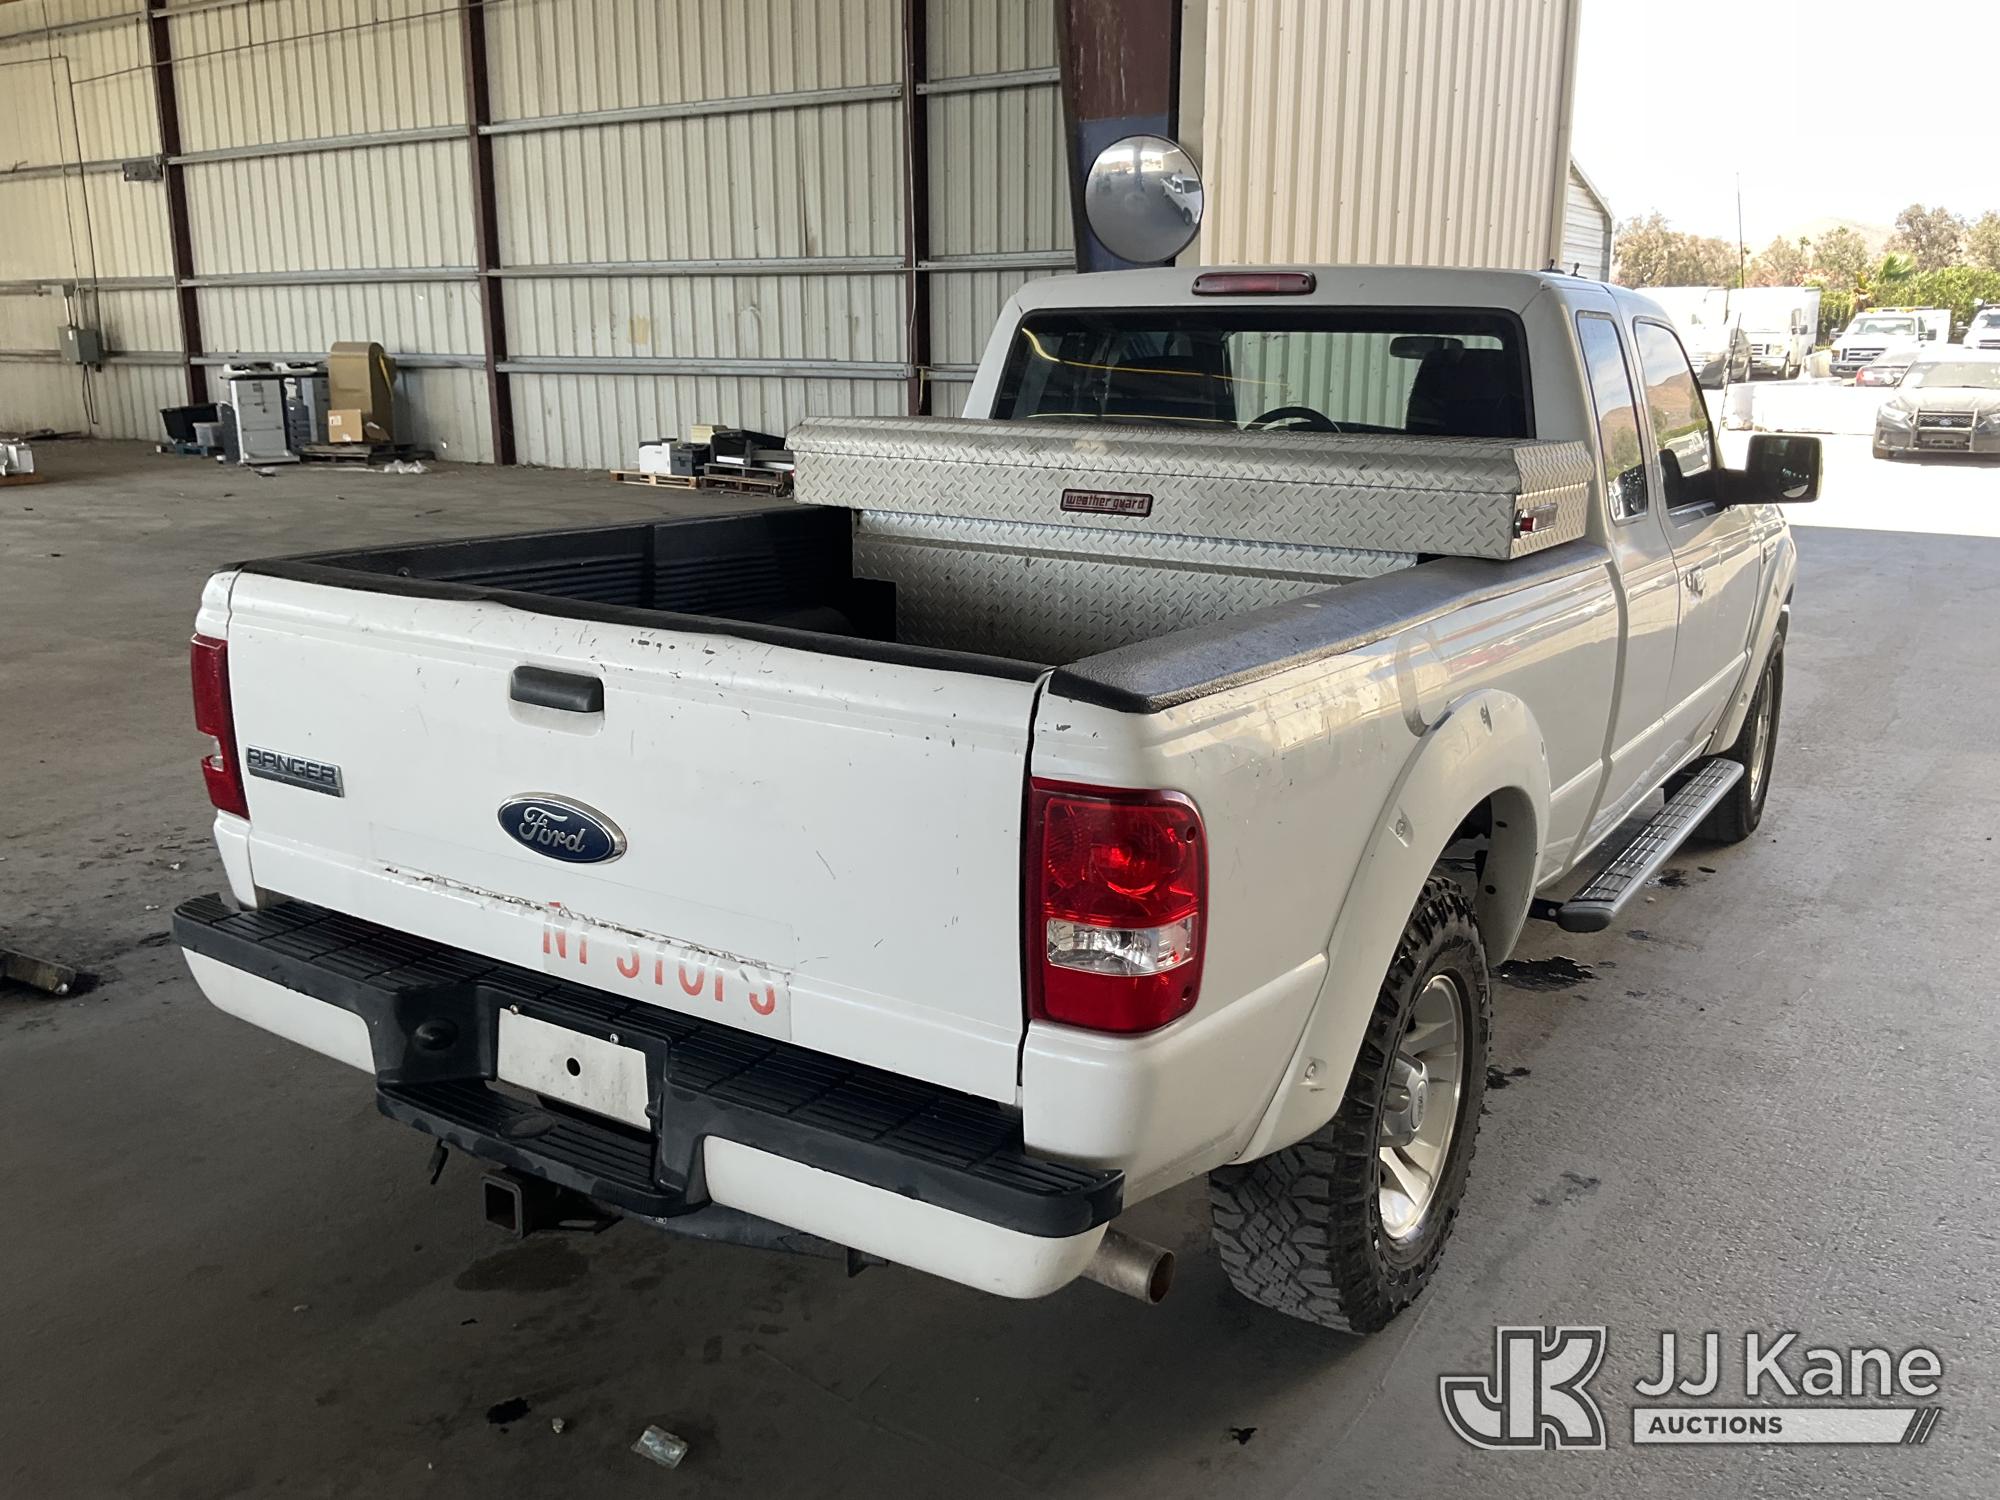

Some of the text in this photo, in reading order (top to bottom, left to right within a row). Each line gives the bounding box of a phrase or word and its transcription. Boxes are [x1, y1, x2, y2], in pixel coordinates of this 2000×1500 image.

[1066, 494, 1145, 511] weather guard
[247, 748, 337, 784] RANGER
[518, 806, 586, 853] Ford
